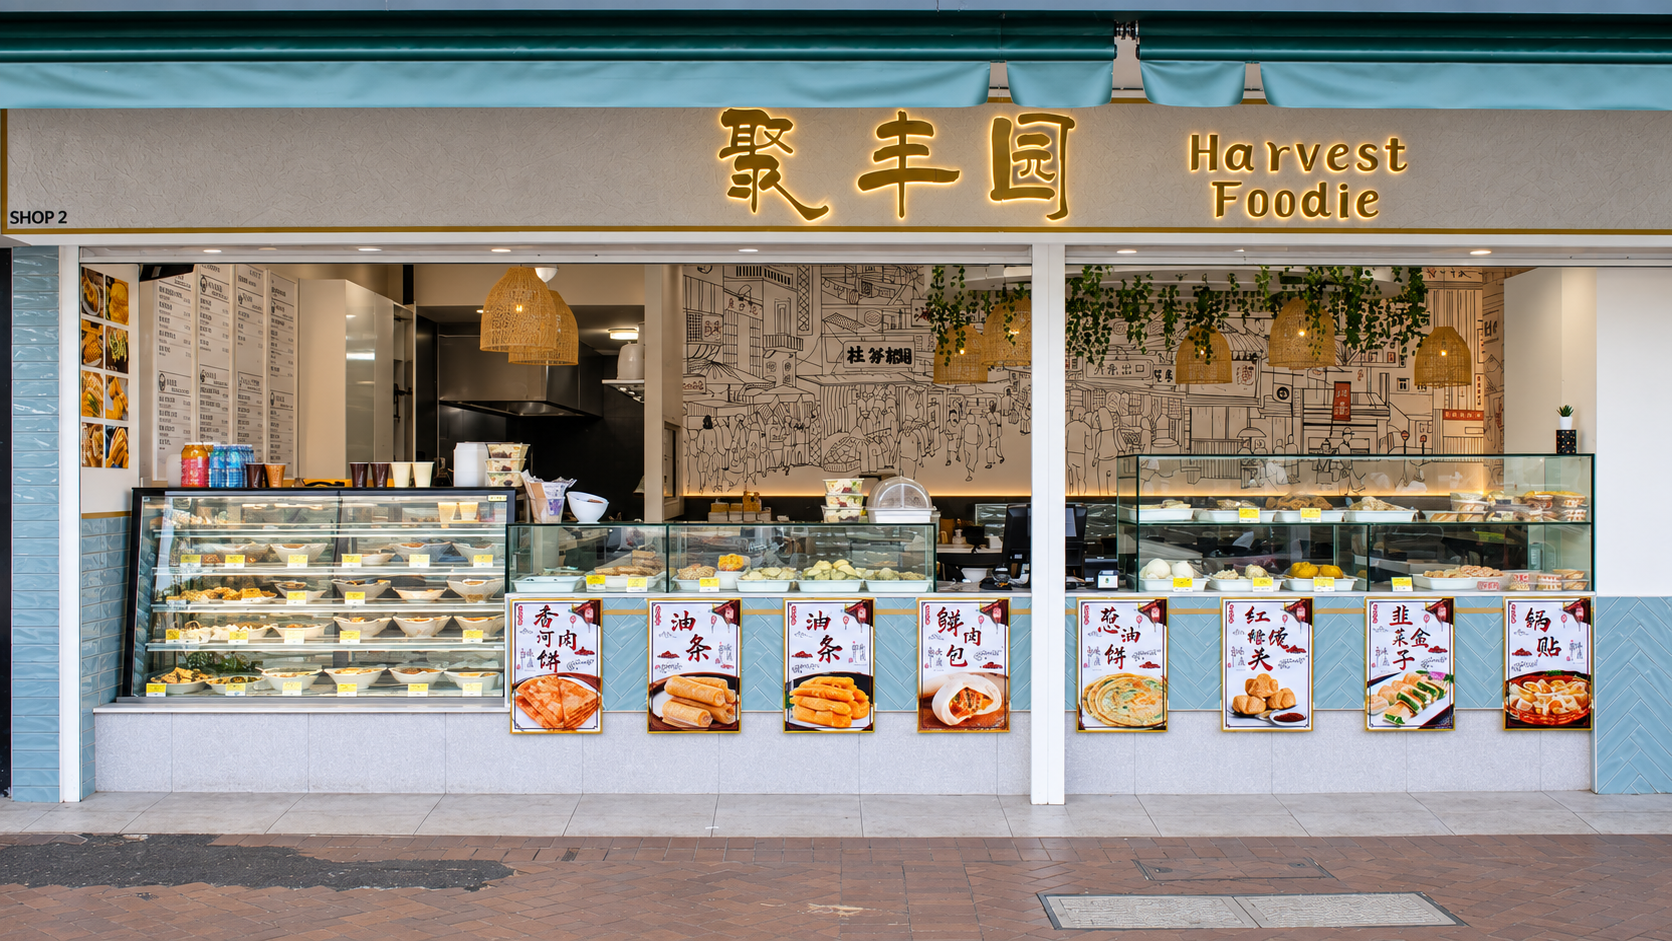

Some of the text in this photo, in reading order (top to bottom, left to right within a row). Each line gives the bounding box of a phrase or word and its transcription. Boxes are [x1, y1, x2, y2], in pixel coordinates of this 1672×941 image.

[718, 107, 1076, 221] 聚丰园
[1188, 133, 1407, 174] Harvest
[11, 210, 68, 224] SHOP 2
[1211, 180, 1380, 220] Foodie
